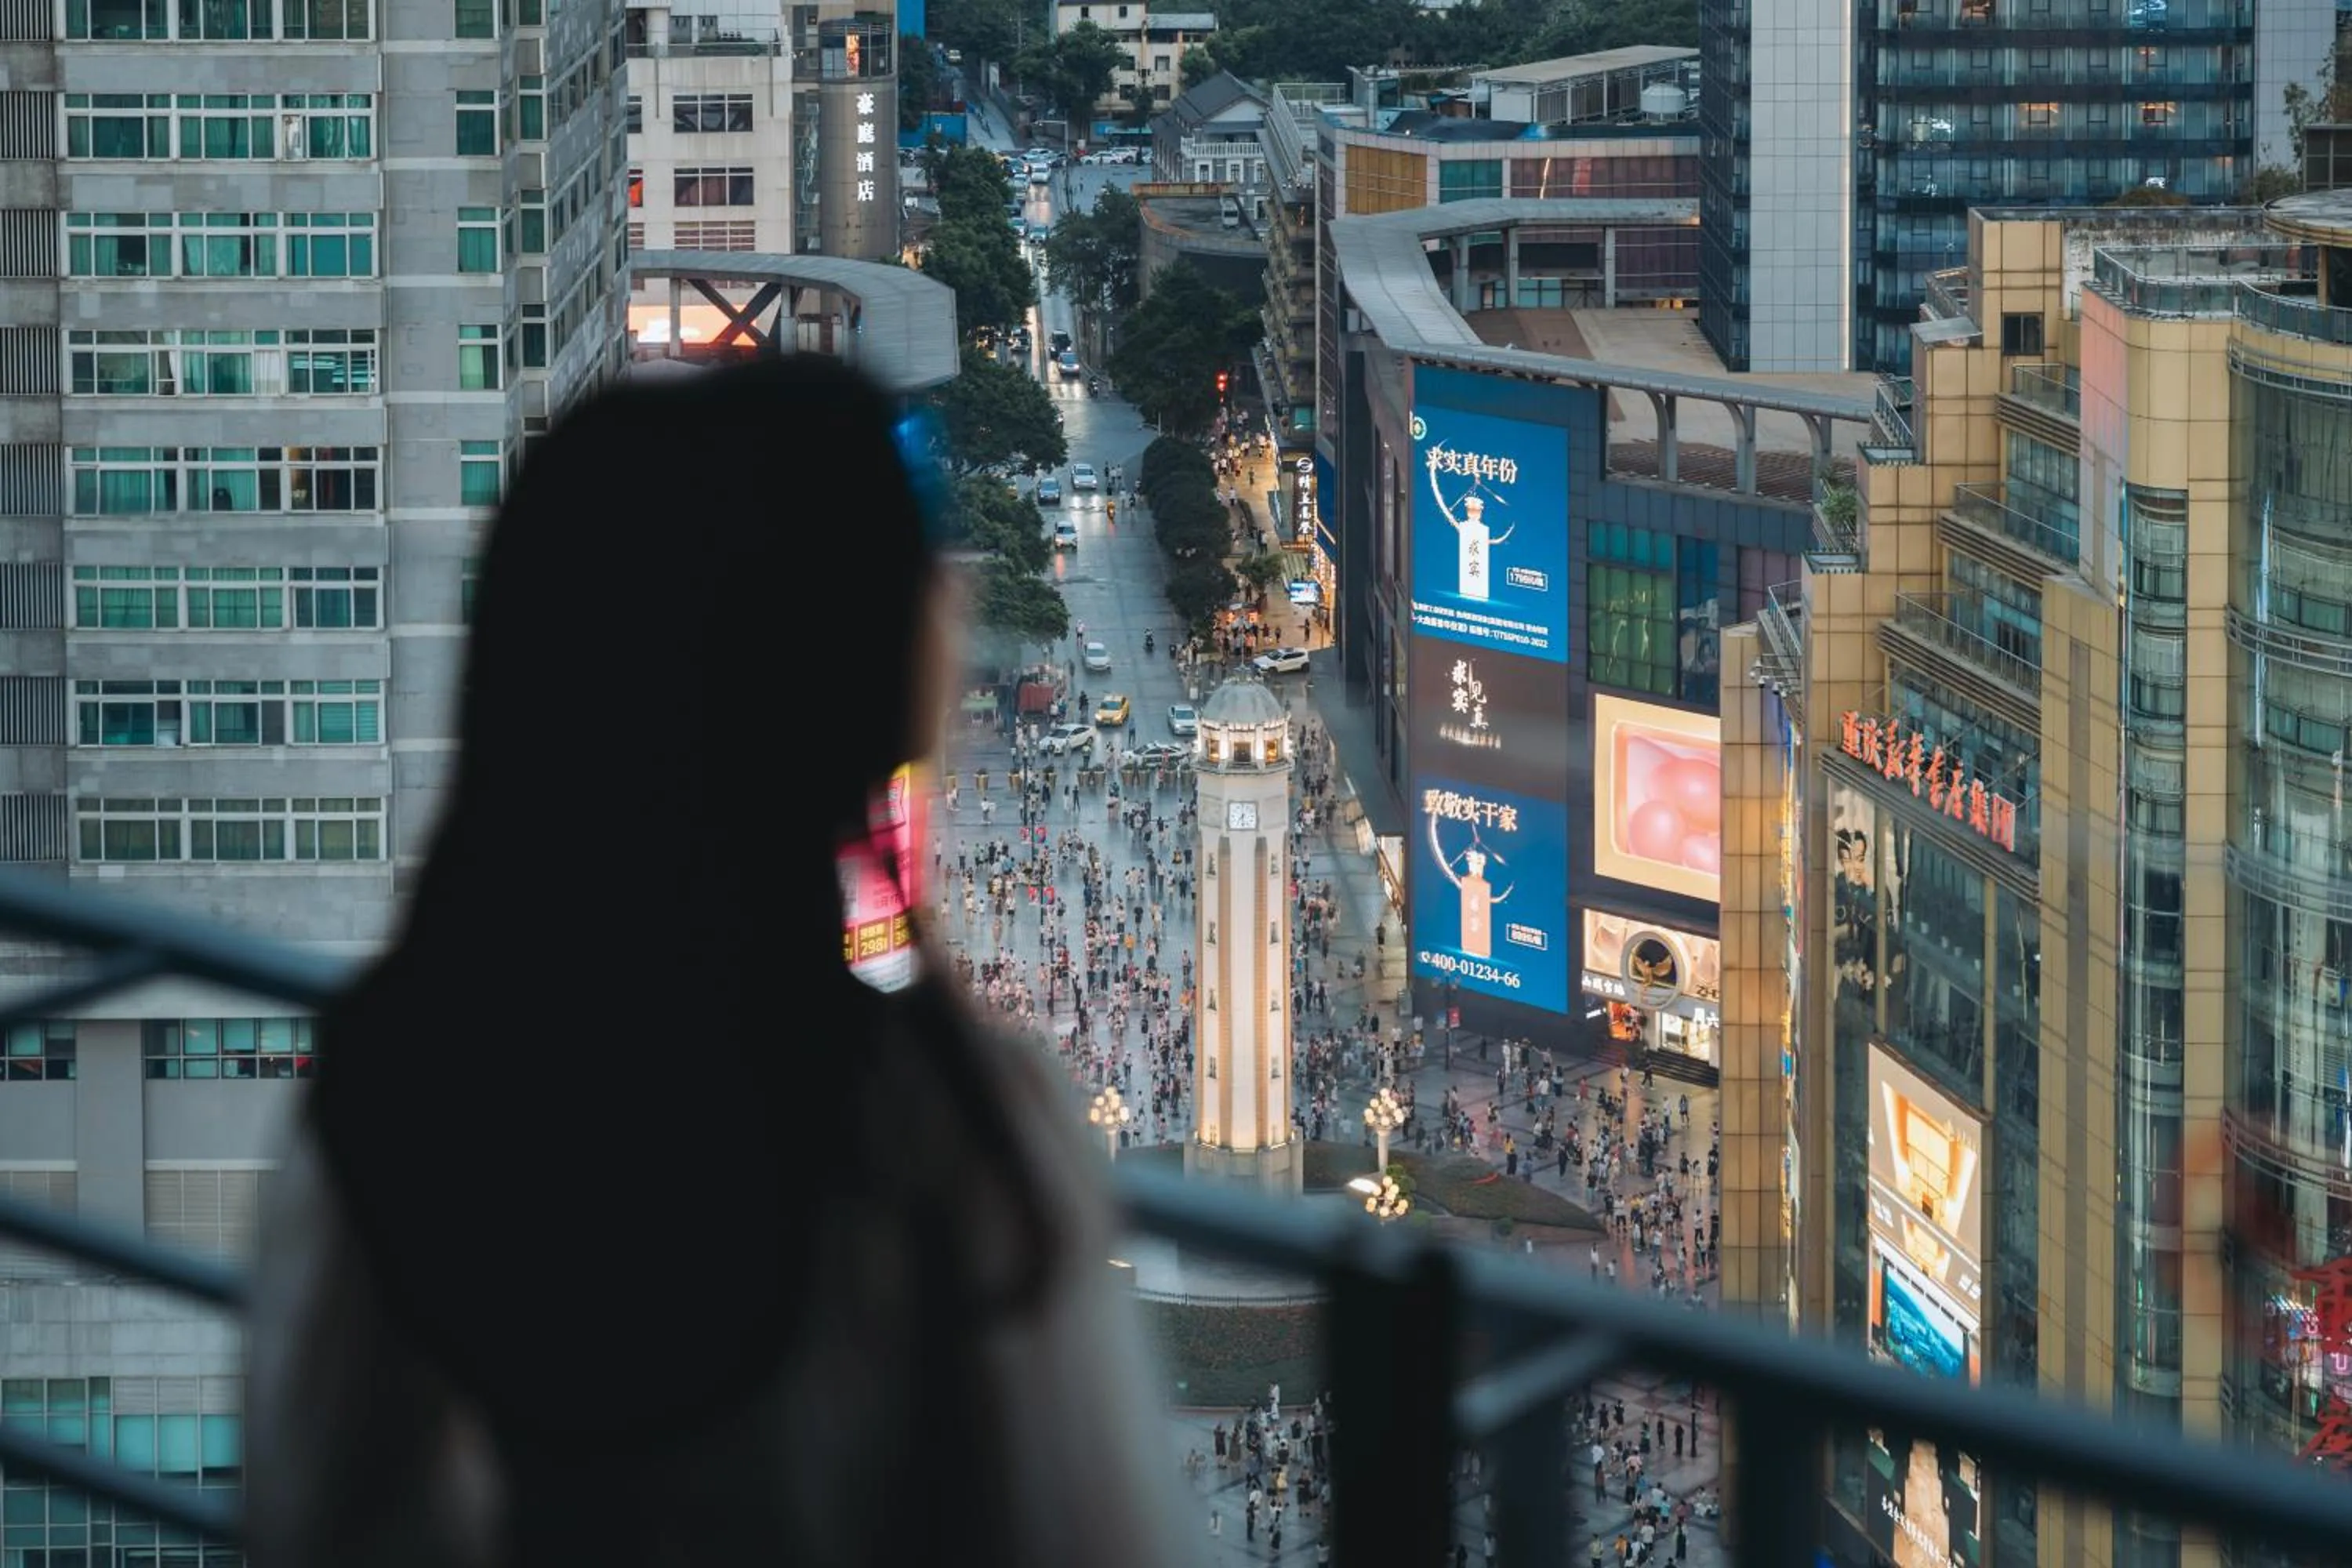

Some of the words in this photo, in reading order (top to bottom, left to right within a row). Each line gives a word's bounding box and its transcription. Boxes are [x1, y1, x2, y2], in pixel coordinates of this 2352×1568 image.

[1425, 446, 1518, 484] 求实真年份
[1422, 789, 1518, 832] 致敬实干家
[1432, 953, 1520, 989] 400-01234-66
